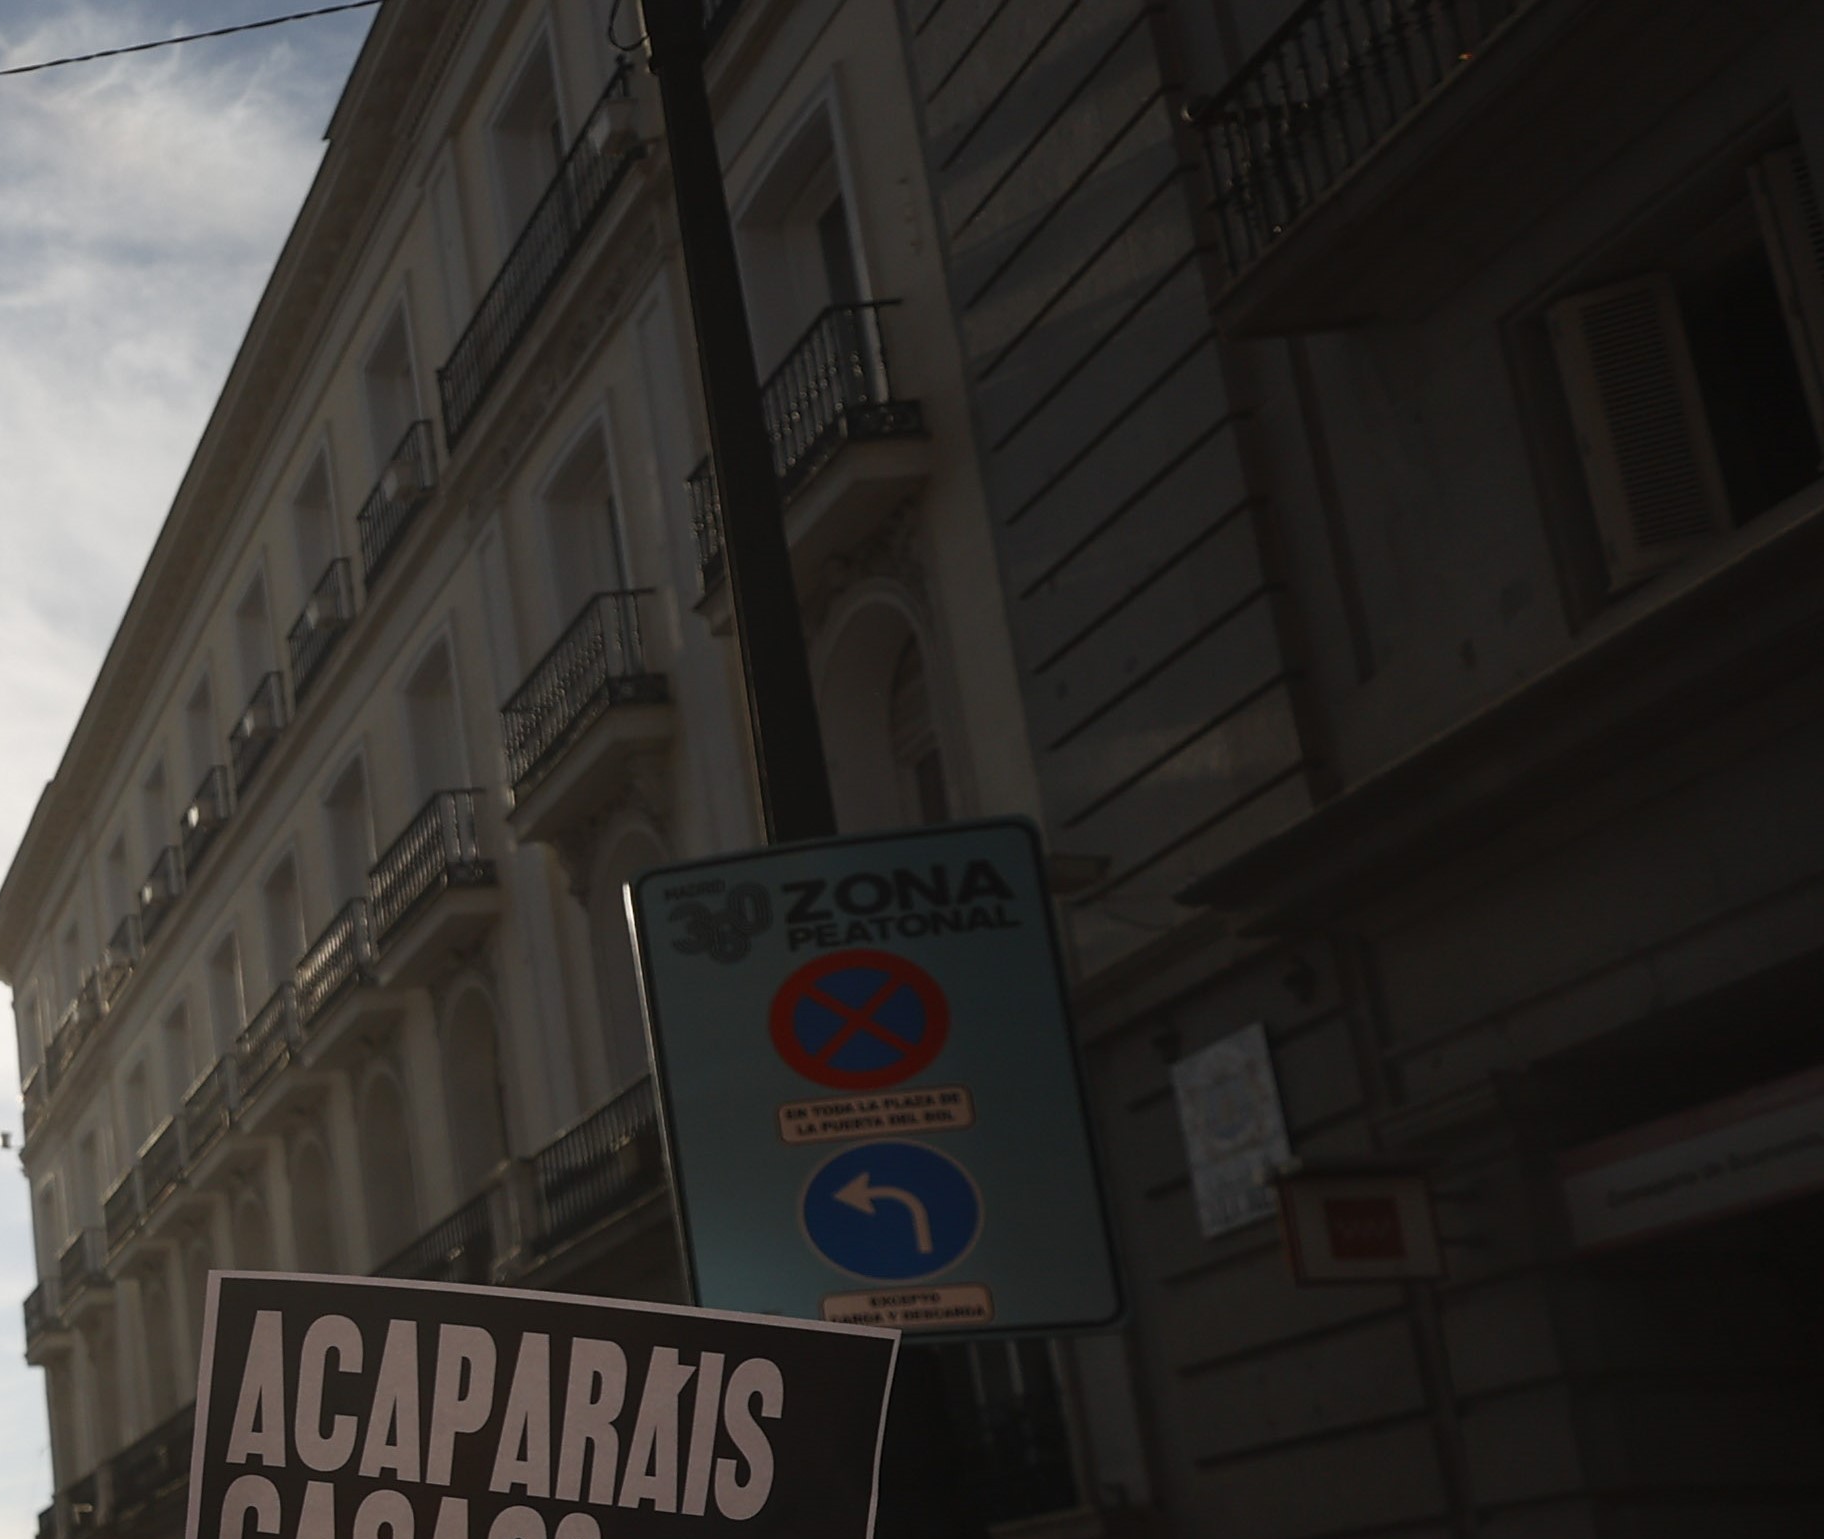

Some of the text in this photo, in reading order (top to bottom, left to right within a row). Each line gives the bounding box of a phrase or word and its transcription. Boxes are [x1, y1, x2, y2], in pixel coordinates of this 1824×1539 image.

[781, 859, 1015, 925] ZONA
[786, 904, 1024, 952] PEATONAL
[226, 1309, 785, 1522] ACAPARÁIS
